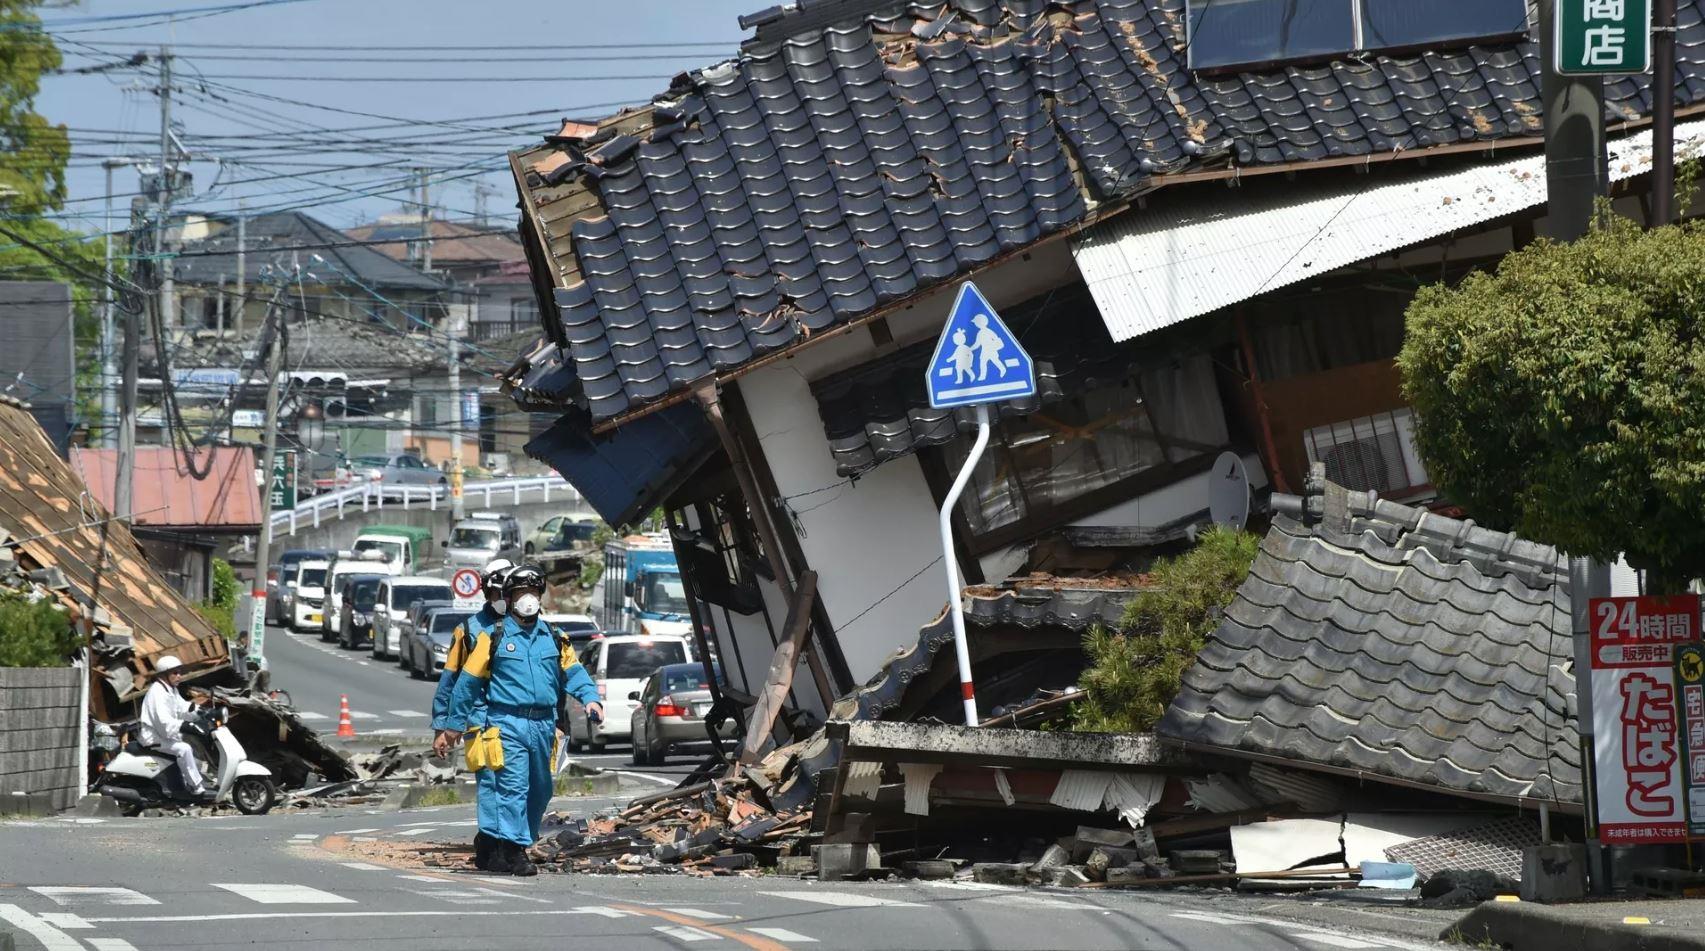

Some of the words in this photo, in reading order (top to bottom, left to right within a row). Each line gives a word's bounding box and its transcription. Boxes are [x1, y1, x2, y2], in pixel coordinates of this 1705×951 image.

[1597, 601, 1691, 640] 24時間
[1622, 645, 1668, 661] 販売中
[1621, 673, 1677, 817] たばこ
